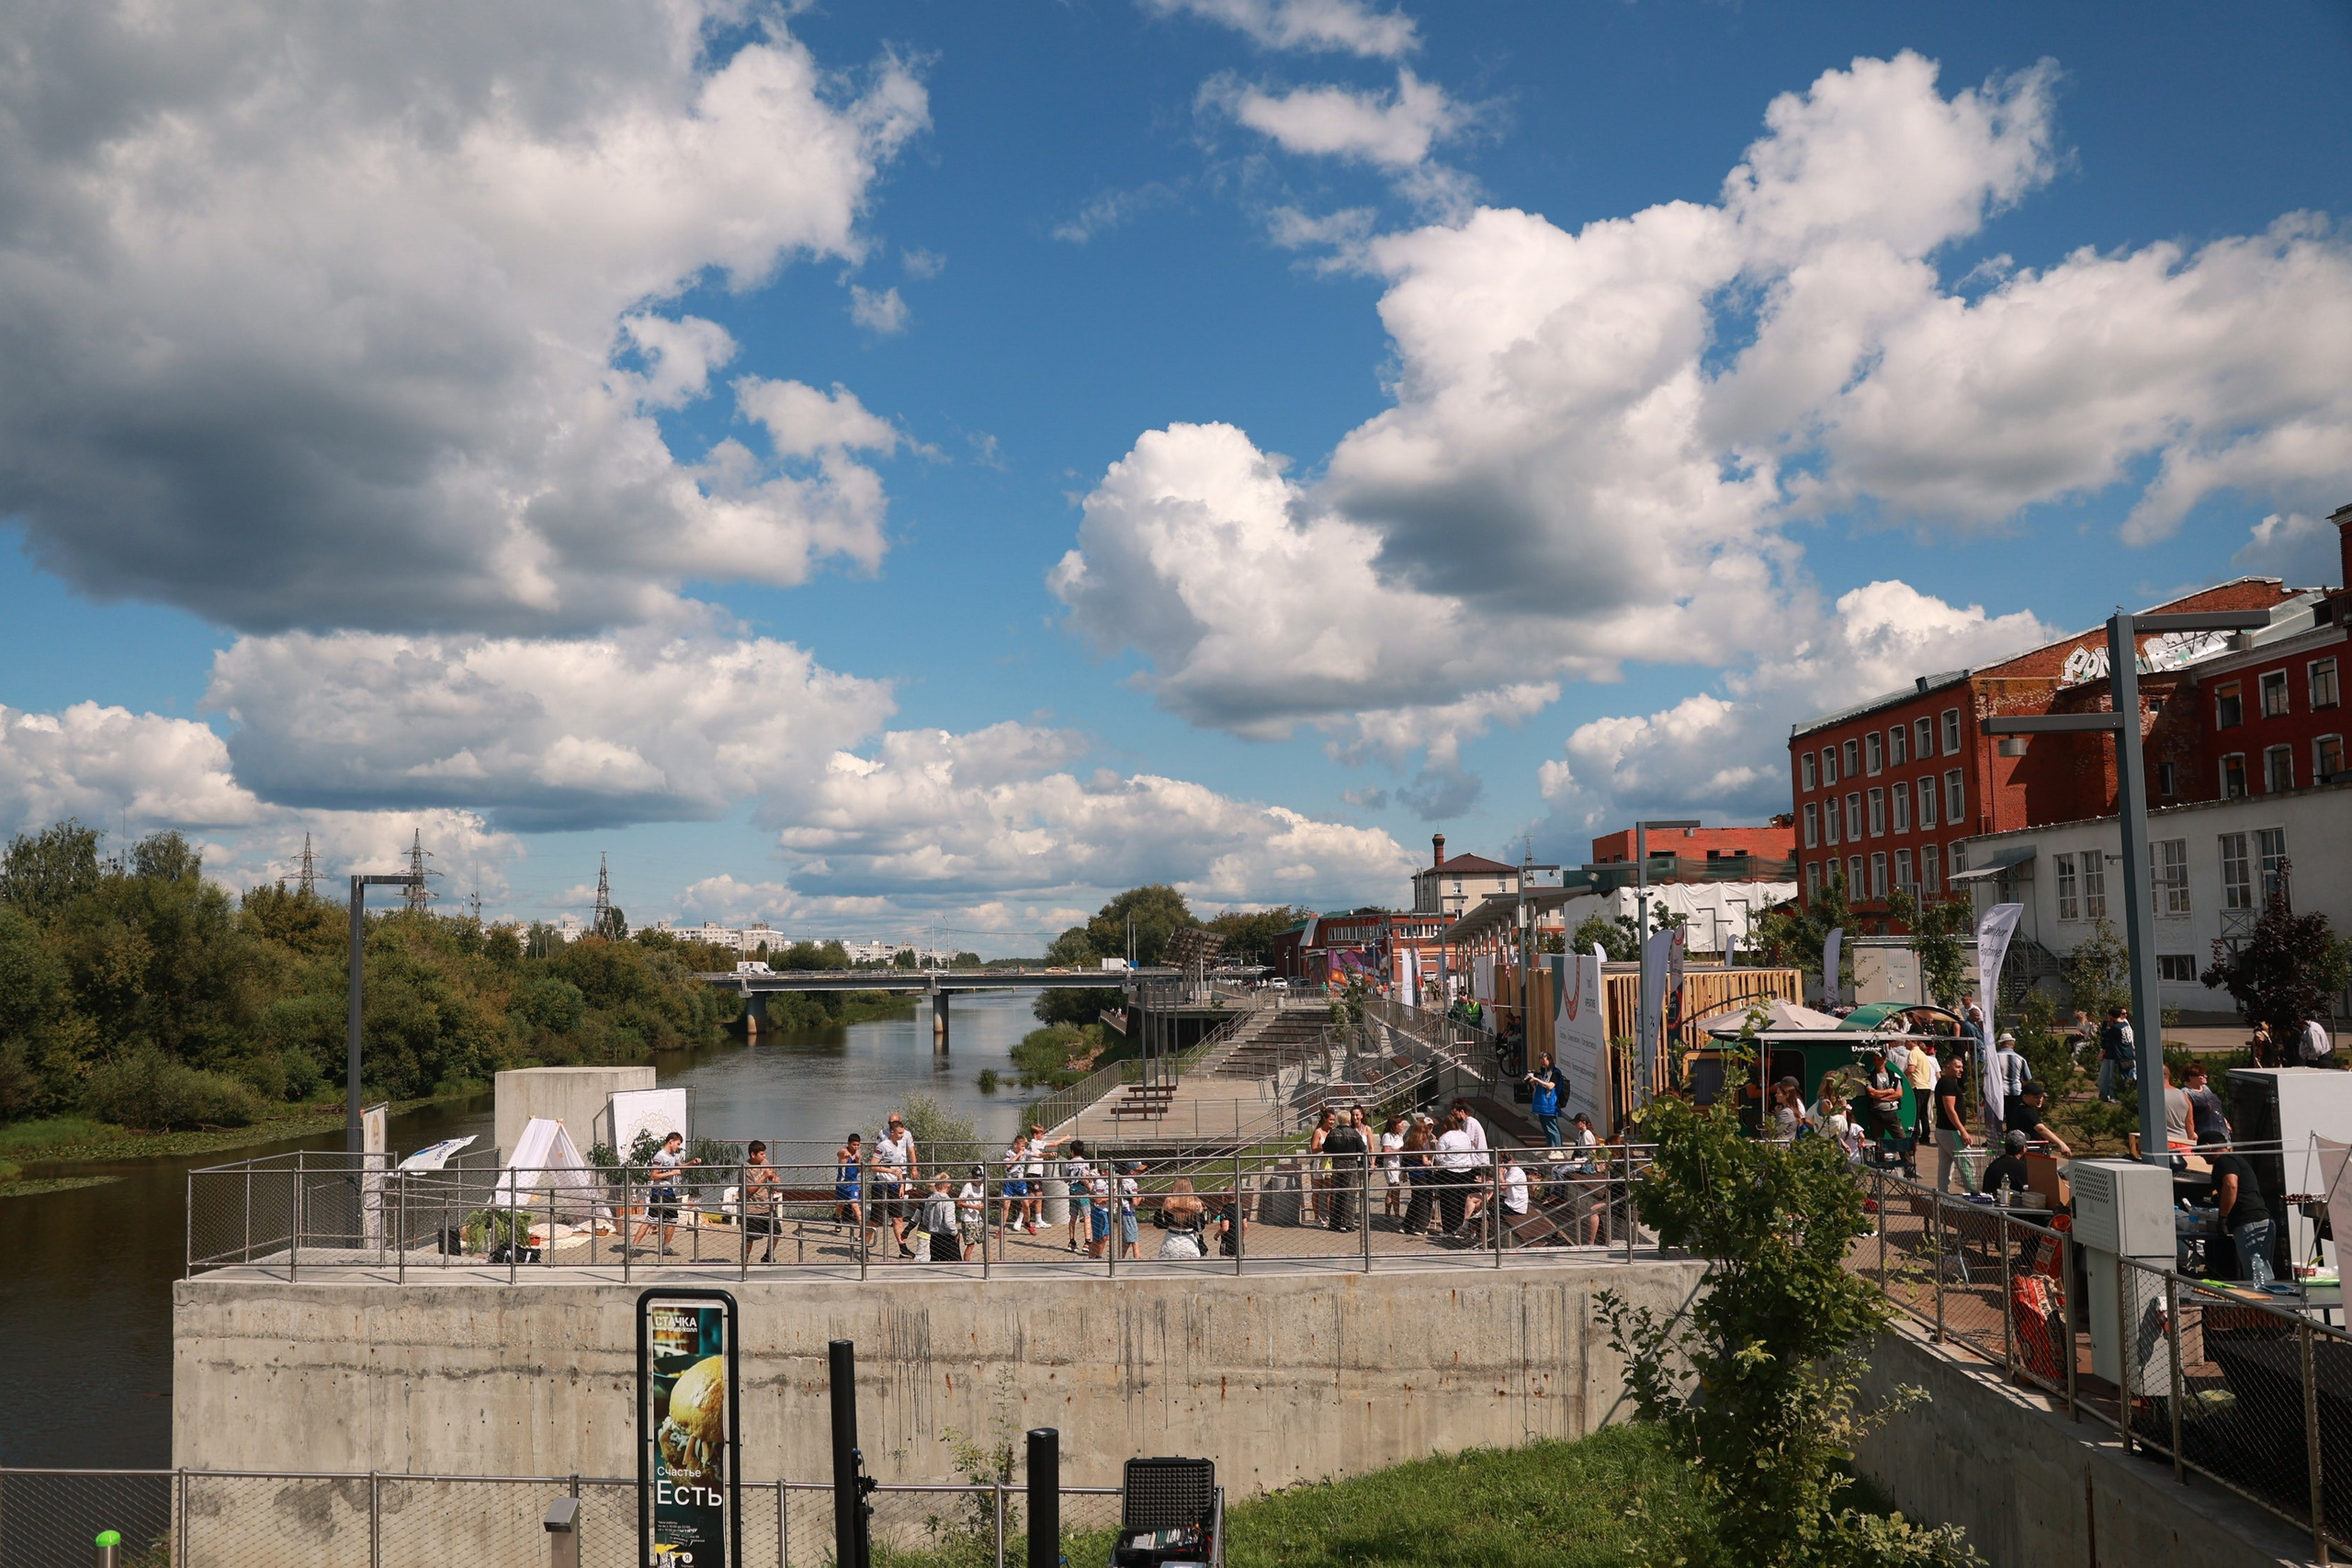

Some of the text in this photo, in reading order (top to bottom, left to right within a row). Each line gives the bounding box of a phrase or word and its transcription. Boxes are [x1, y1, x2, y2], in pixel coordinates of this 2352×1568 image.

[655, 1316, 697, 1326] СТАЧКА
[657, 1466, 701, 1477] Счастье
[657, 1480, 722, 1506] Есть
